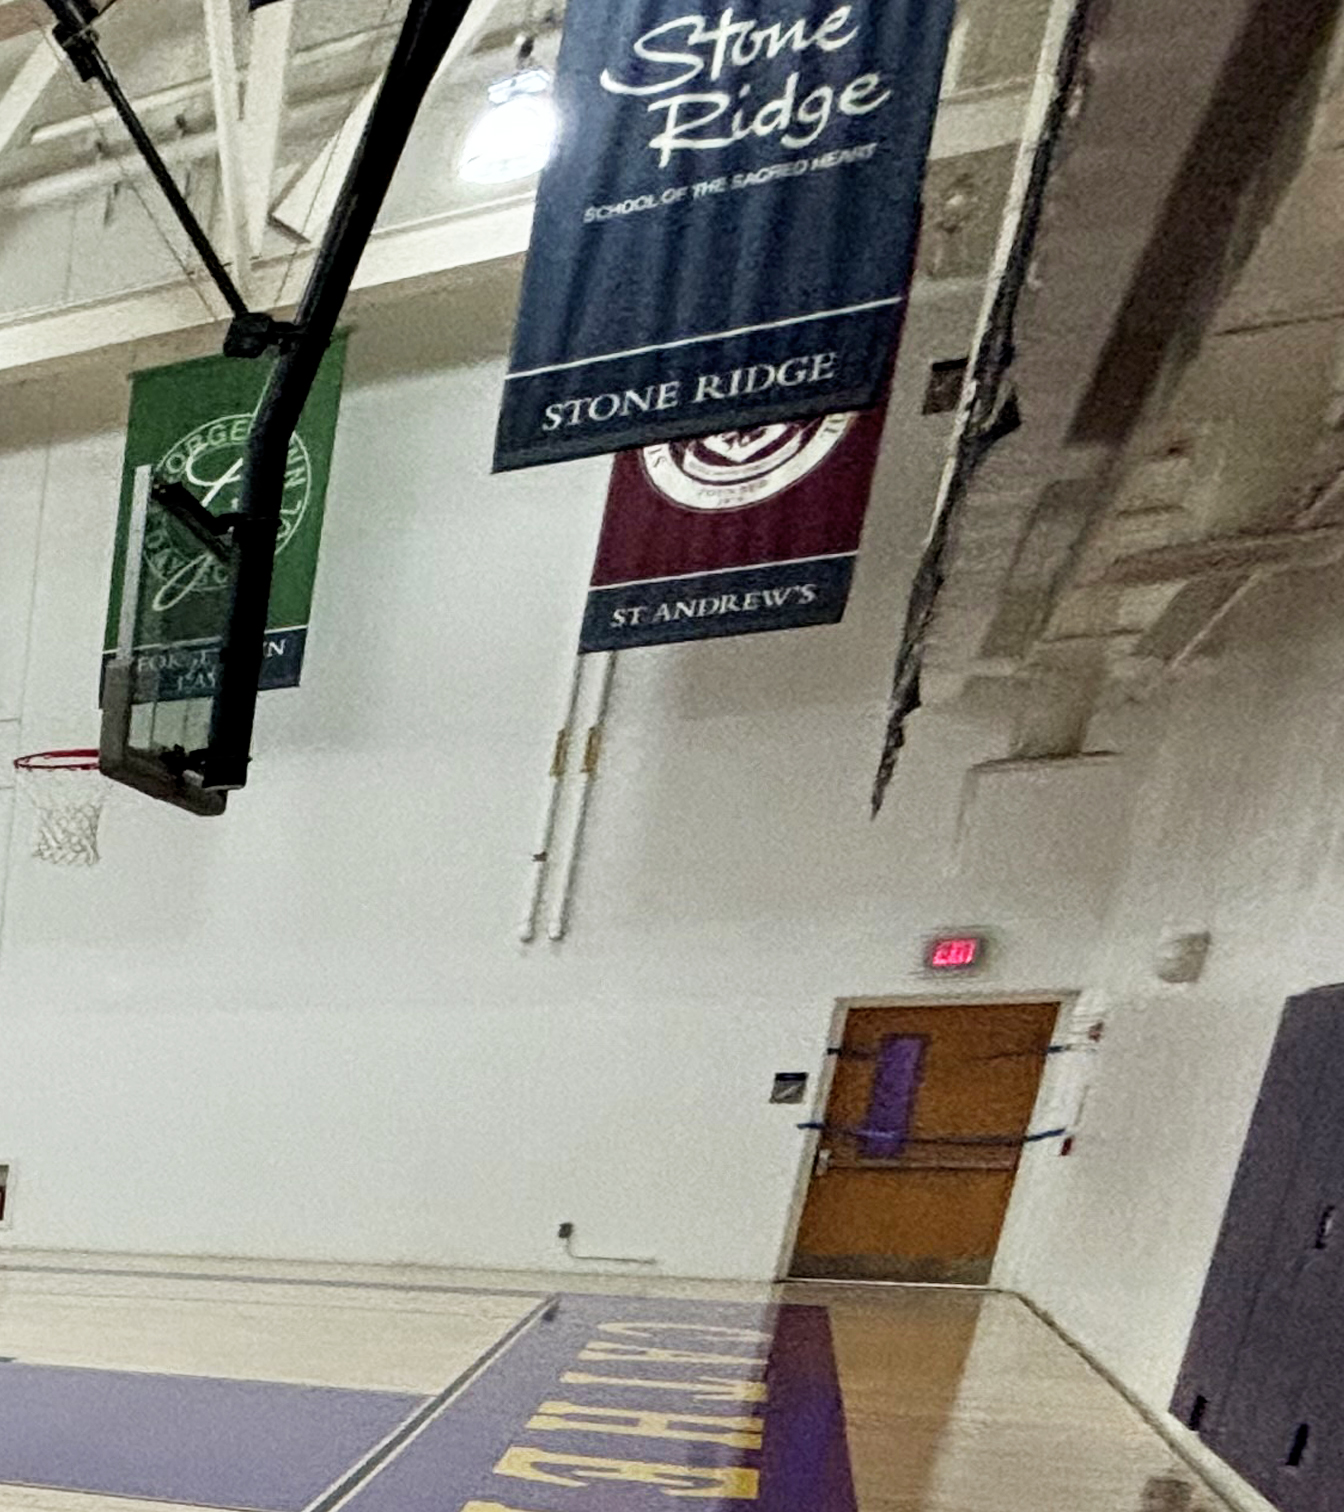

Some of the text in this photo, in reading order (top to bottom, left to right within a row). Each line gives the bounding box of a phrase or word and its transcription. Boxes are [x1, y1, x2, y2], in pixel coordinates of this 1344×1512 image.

[599, 5, 859, 96] Stone
[647, 71, 892, 169] Ridge
[582, 193, 661, 224] SCHOOL
[660, 186, 688, 206] OF
[691, 177, 726, 201] THE
[541, 351, 839, 432] STONE RIDGE
[611, 582, 818, 628] ST ANDREW'S
